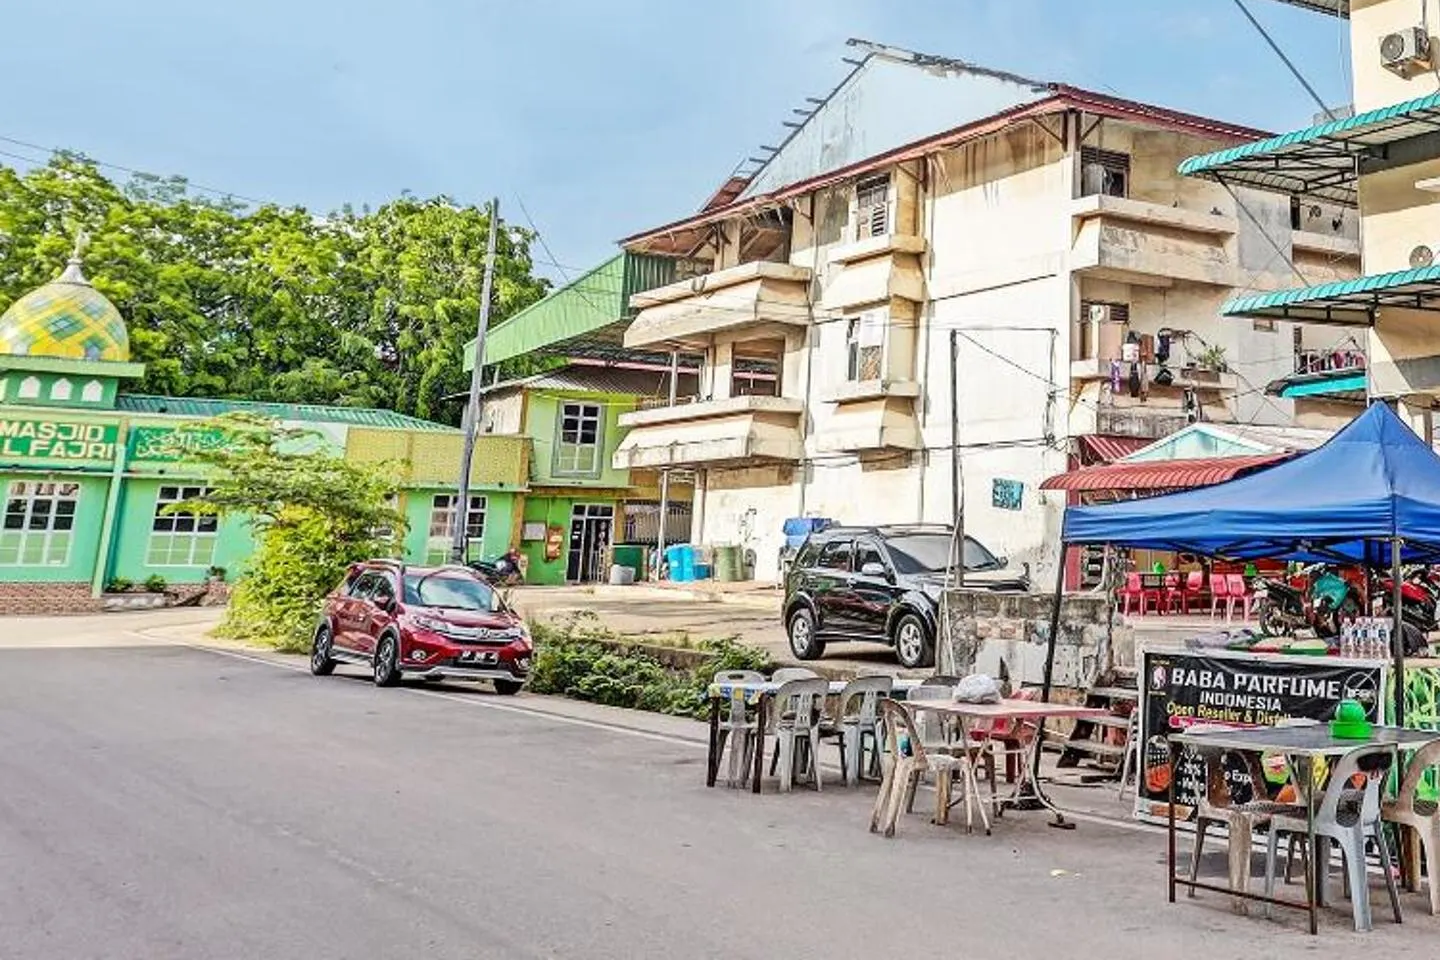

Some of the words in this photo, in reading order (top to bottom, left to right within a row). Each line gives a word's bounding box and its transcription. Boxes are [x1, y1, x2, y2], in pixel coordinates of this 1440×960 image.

[0, 421, 104, 442] MASJID
[28, 438, 115, 459] FAJRI
[1172, 668, 1226, 690] BABA
[1234, 674, 1341, 700] PARFUME
[1166, 701, 1195, 717] Open
[1198, 704, 1242, 722] Reseller
[1200, 691, 1282, 712] INDONESIA
